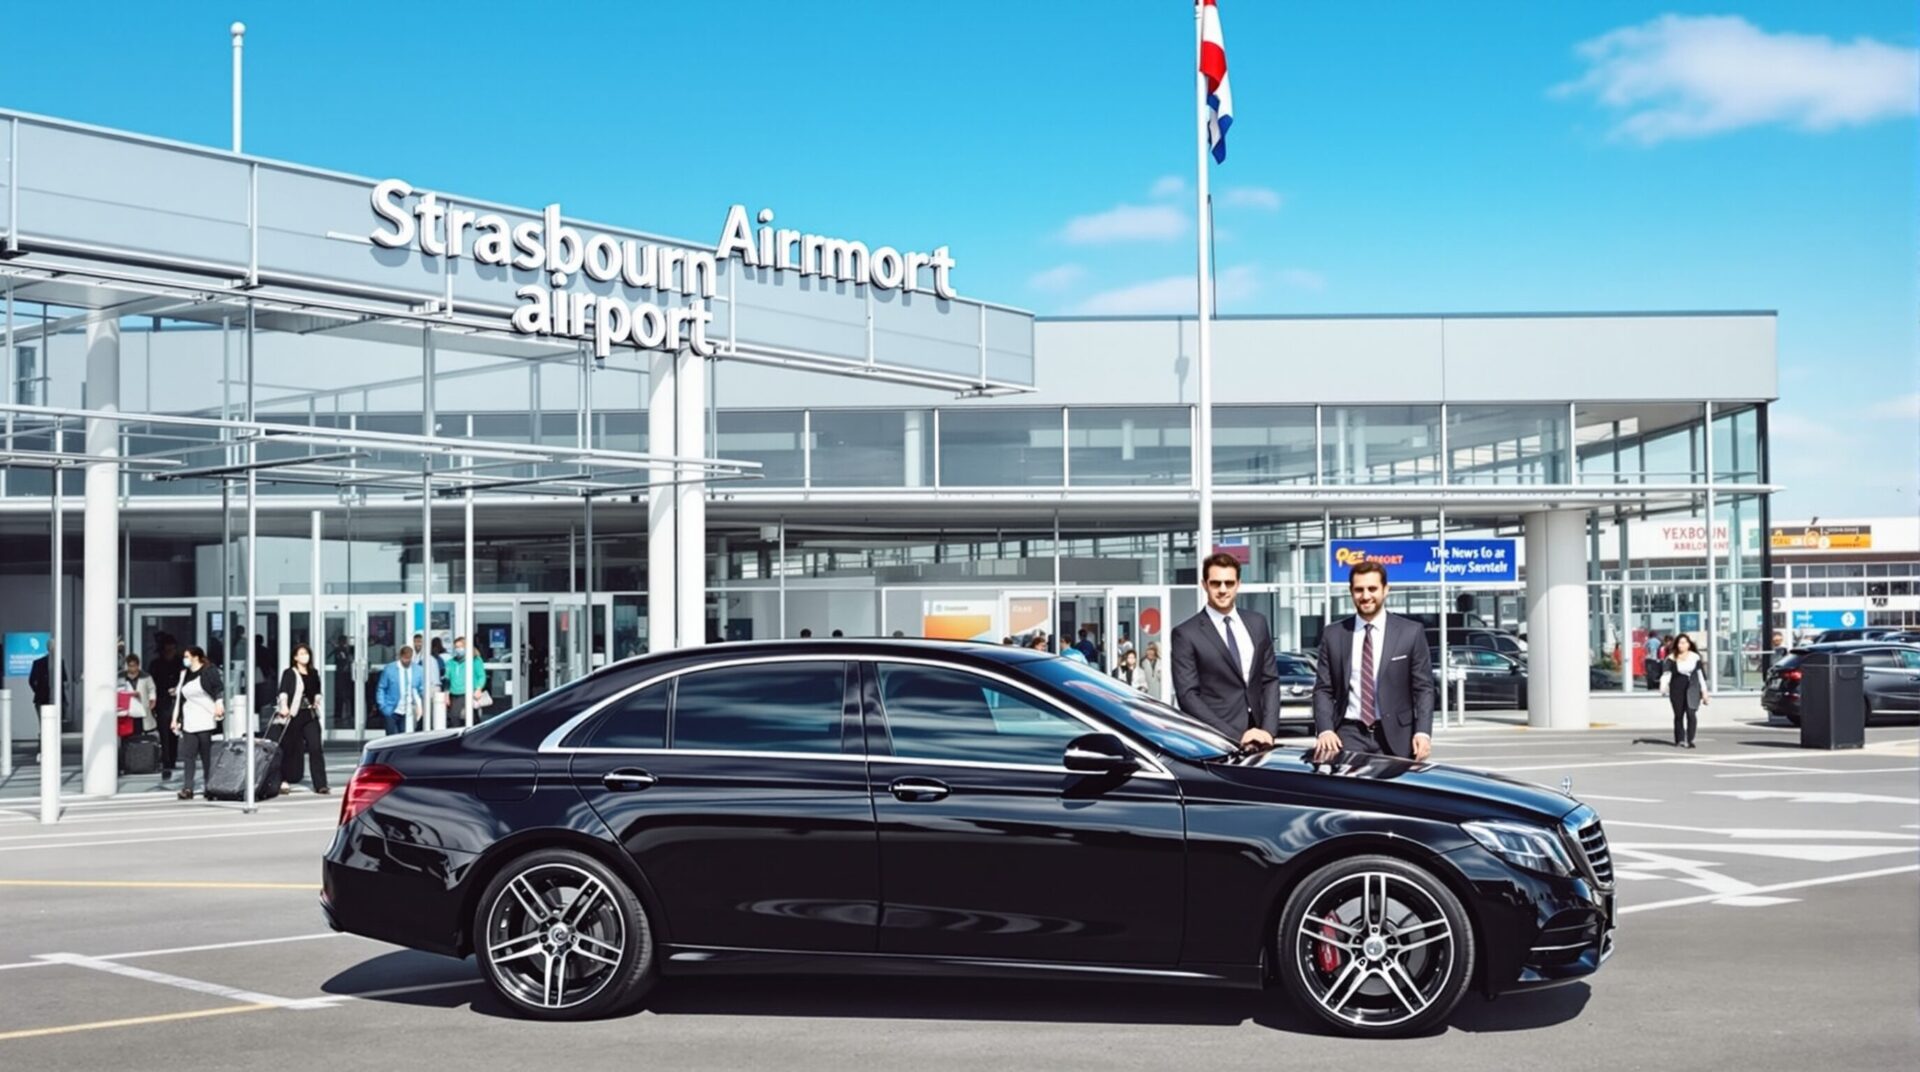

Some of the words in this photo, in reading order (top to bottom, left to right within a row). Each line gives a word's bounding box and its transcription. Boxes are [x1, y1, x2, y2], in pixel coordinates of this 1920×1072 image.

[370, 178, 716, 298] Strasbourn
[511, 271, 714, 358] airport
[1451, 546, 1479, 559] News
